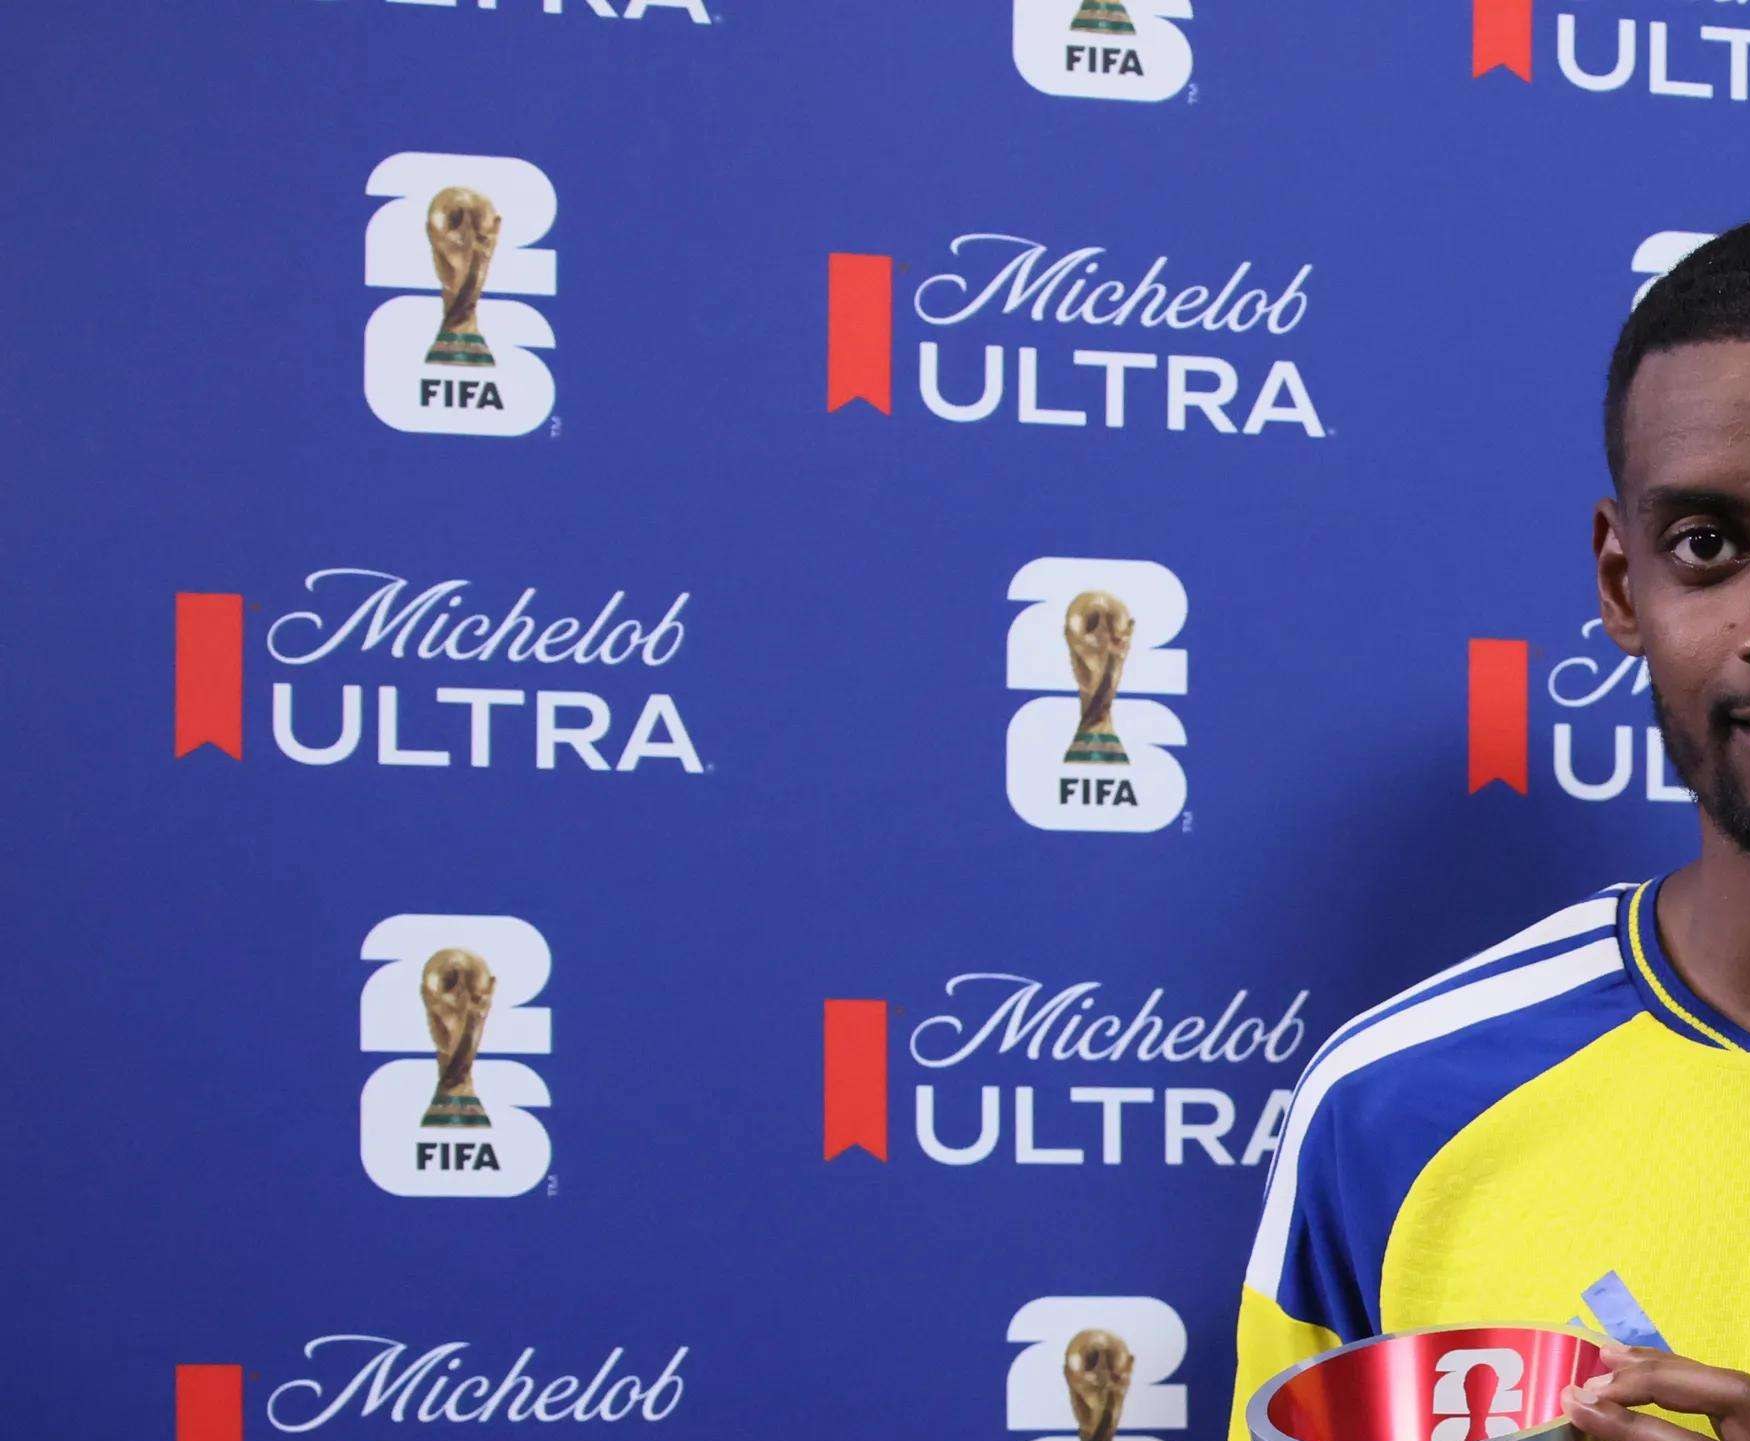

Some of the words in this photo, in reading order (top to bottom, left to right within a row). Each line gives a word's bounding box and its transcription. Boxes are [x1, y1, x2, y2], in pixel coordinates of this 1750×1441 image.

[1066, 45, 1144, 77] FIFA
[913, 232, 1313, 335] Michelob
[420, 378, 504, 411] FIFA
[918, 340, 1327, 438] ULTRA
[267, 566, 690, 666] Michelob
[272, 682, 706, 775] ULTRA
[1059, 777, 1138, 807] FIFA
[909, 972, 1310, 1069] Michelob
[416, 1142, 501, 1171] FIFA
[267, 1334, 690, 1433] Michelob
